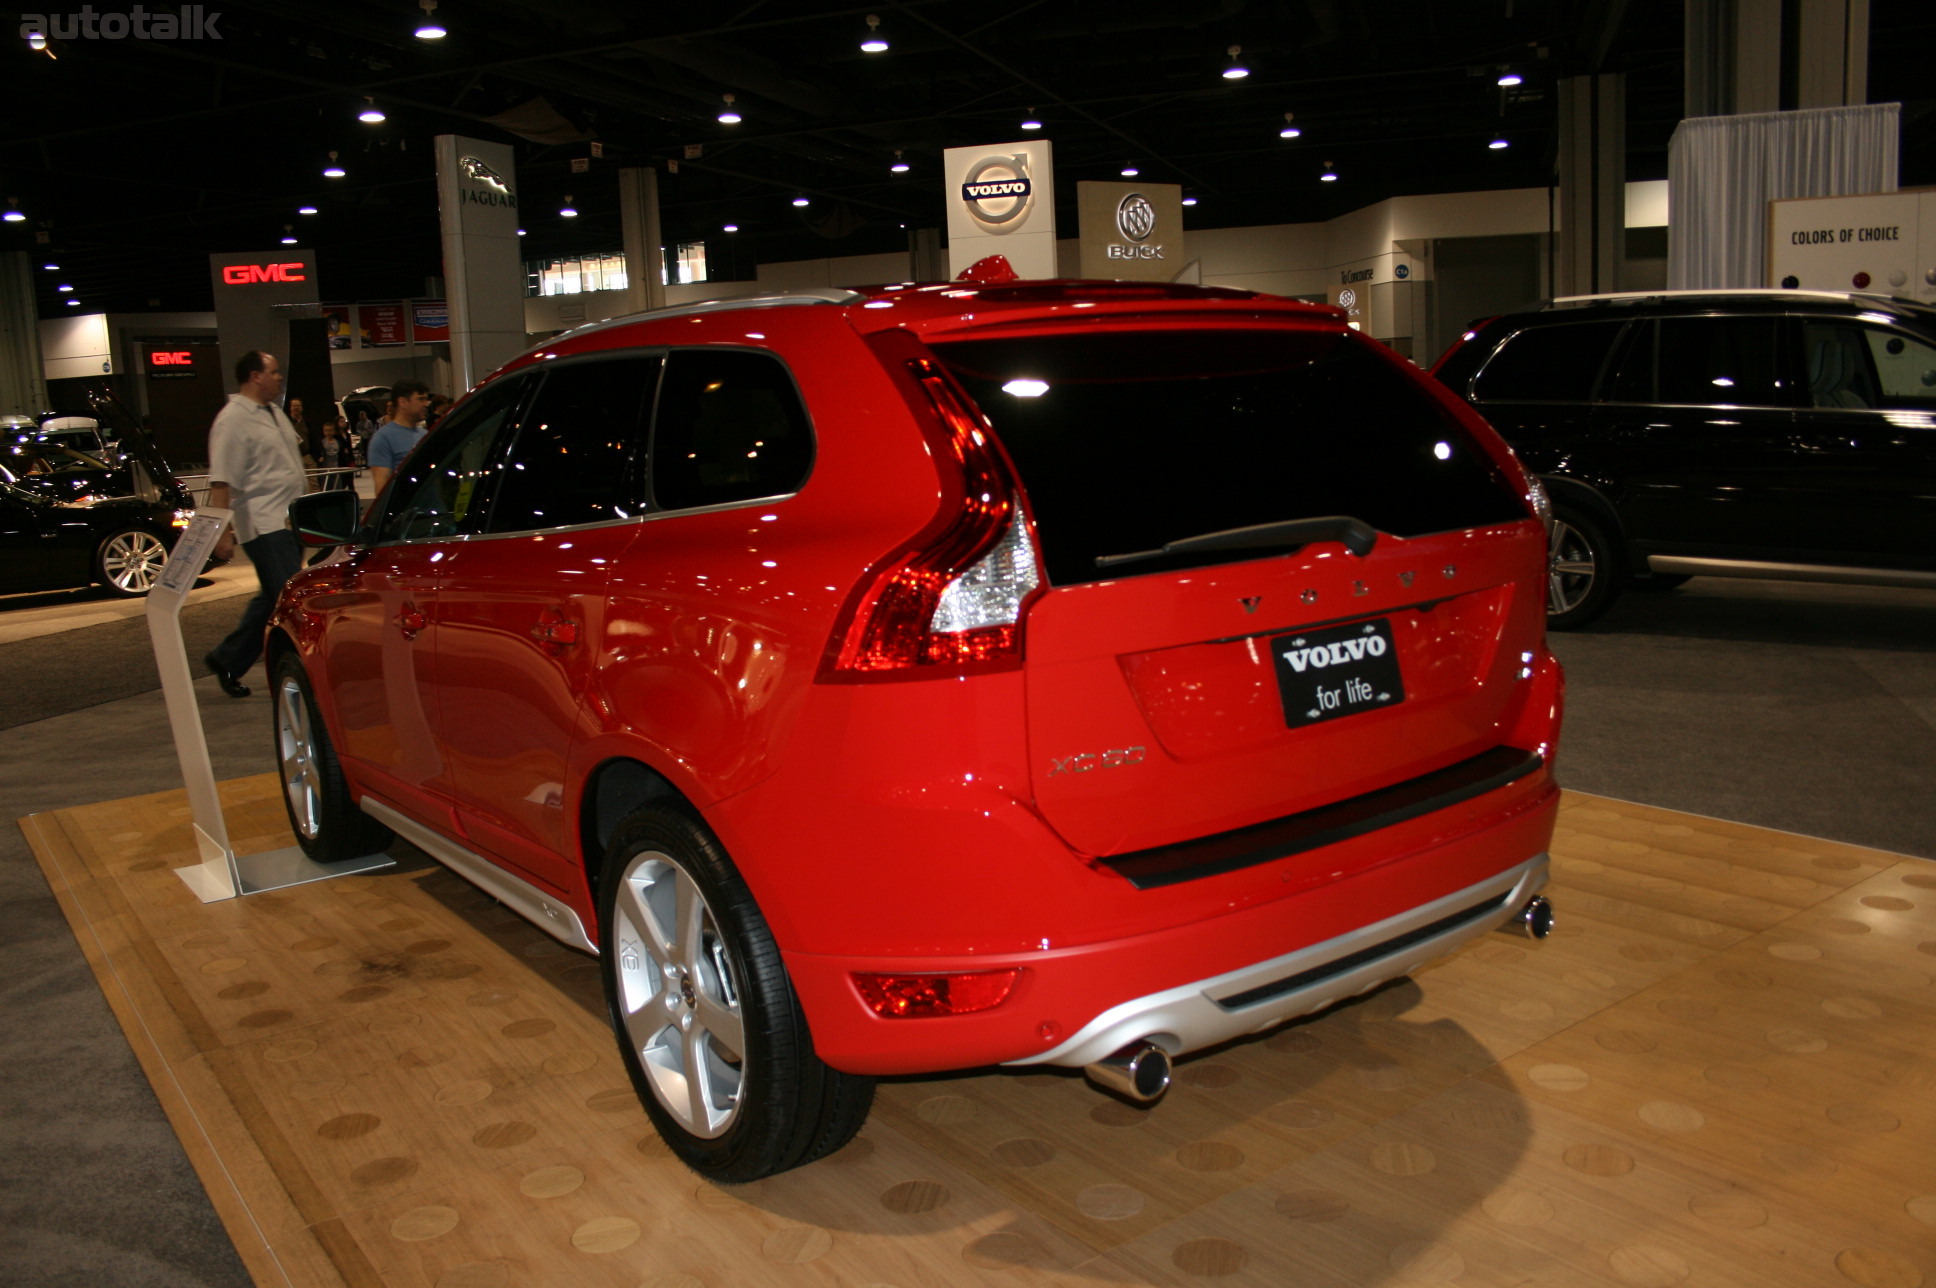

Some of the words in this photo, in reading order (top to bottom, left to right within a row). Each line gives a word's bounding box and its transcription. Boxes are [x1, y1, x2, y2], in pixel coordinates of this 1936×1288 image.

[461, 188, 517, 209] JAGUAR
[966, 182, 1026, 197] VOLVO
[1791, 229, 1834, 245] COLORS
[1839, 228, 1854, 243] OF
[1858, 226, 1899, 242] CHOICE
[1107, 244, 1165, 259] BUICK
[223, 262, 306, 285] GMC
[151, 351, 192, 366] GMC
[1237, 564, 1457, 614] VOLVO
[1283, 635, 1387, 673] VOLVO
[1316, 685, 1341, 710] for
[1345, 677, 1373, 704] life
